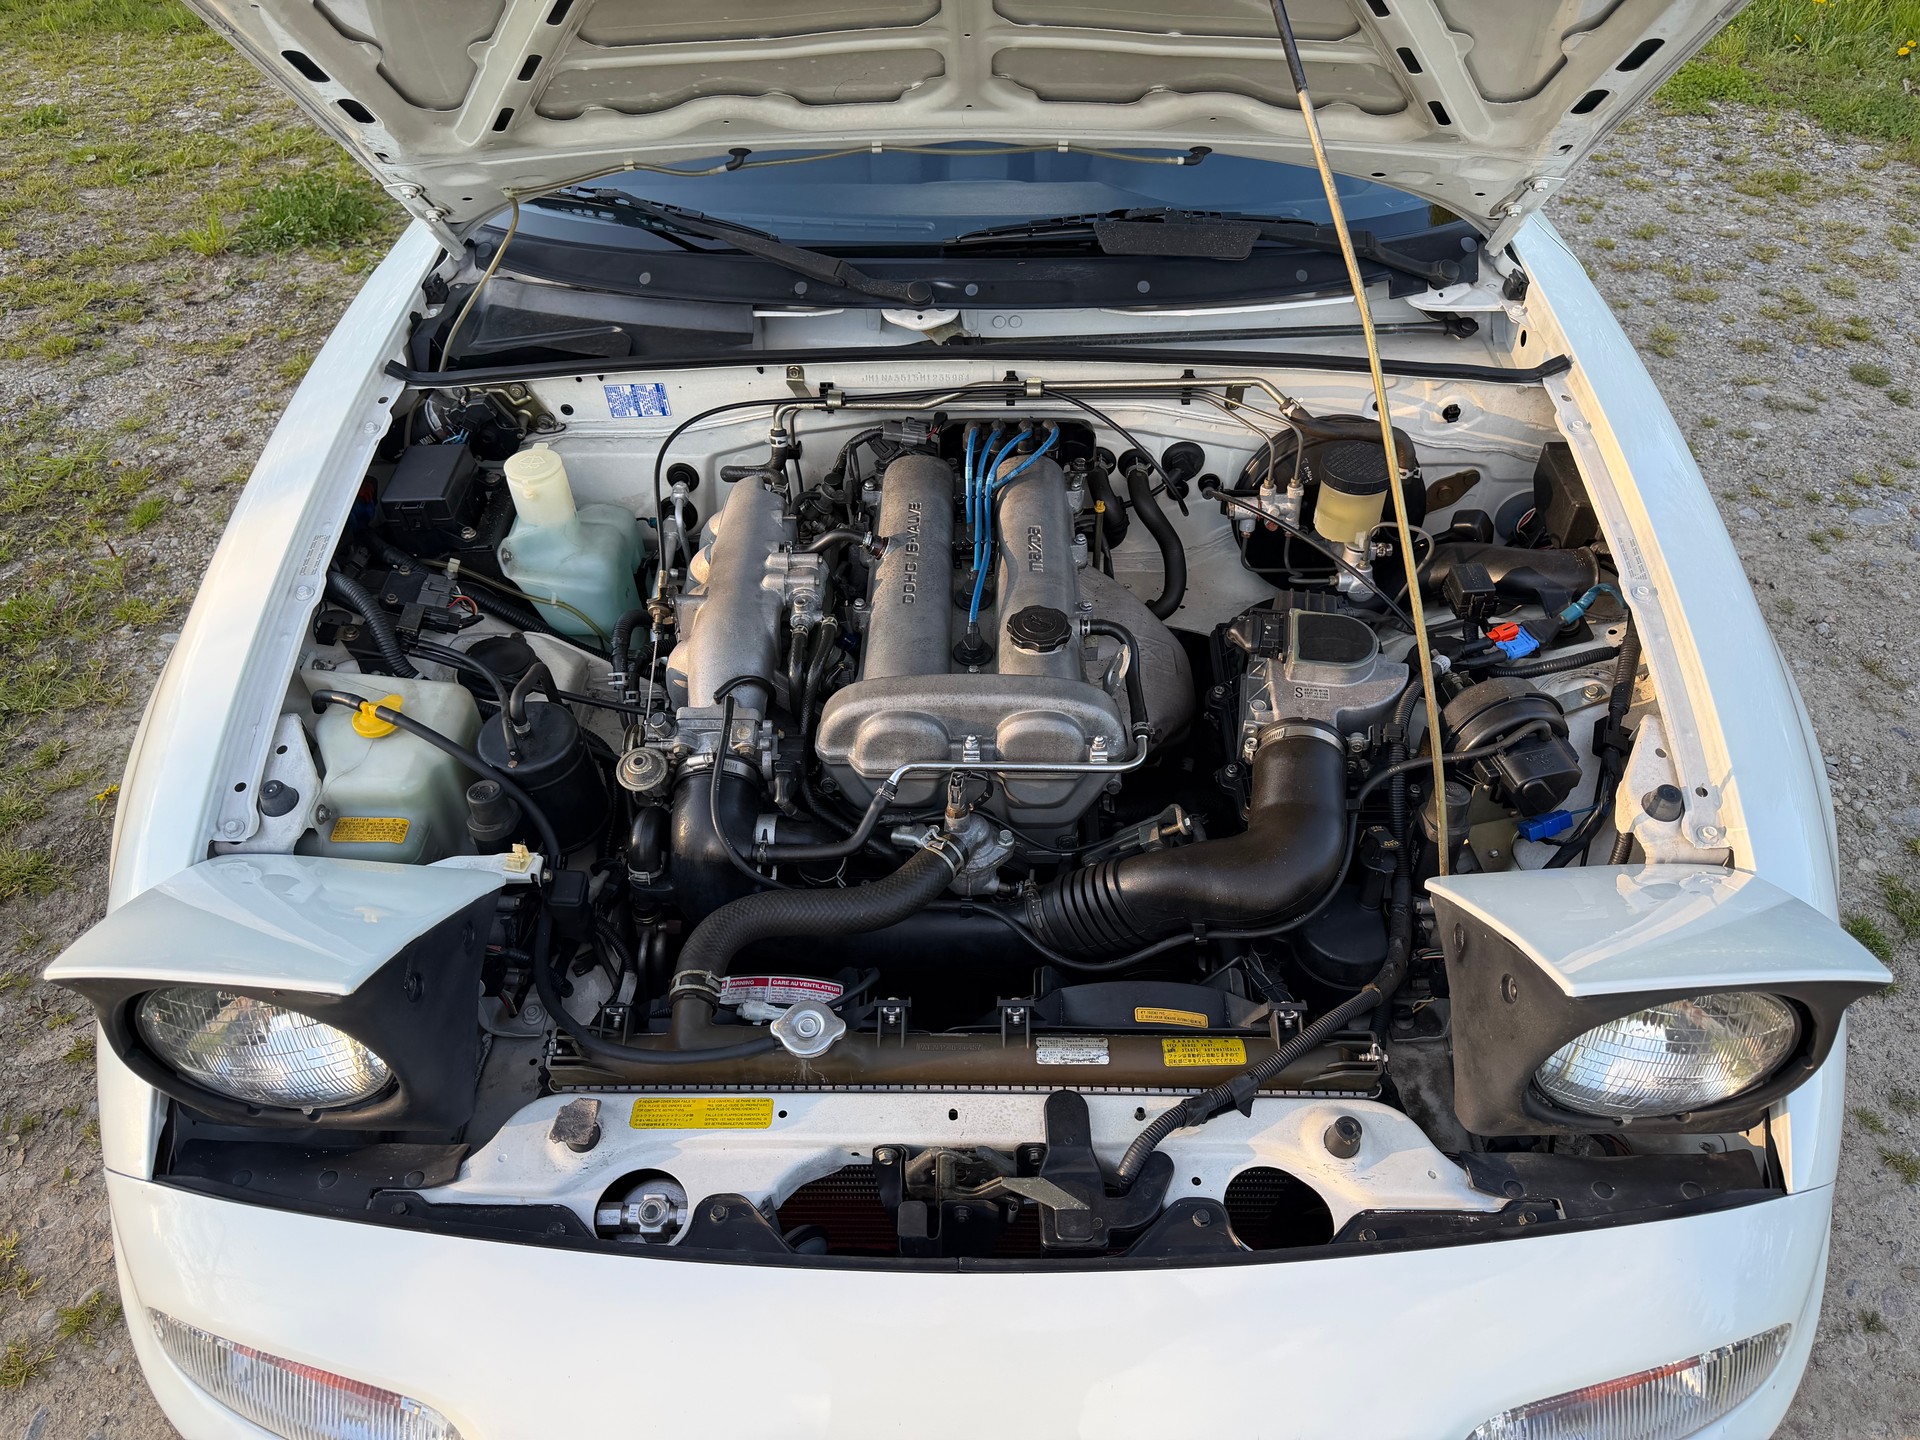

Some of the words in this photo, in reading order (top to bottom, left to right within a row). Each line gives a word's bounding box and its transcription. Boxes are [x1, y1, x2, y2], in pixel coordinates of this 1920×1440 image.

[905, 502, 922, 557] 16-VALVE
[902, 561, 917, 604] DOHC
[1295, 687, 1303, 698] S
[799, 981, 840, 993] VENTILATEUR
